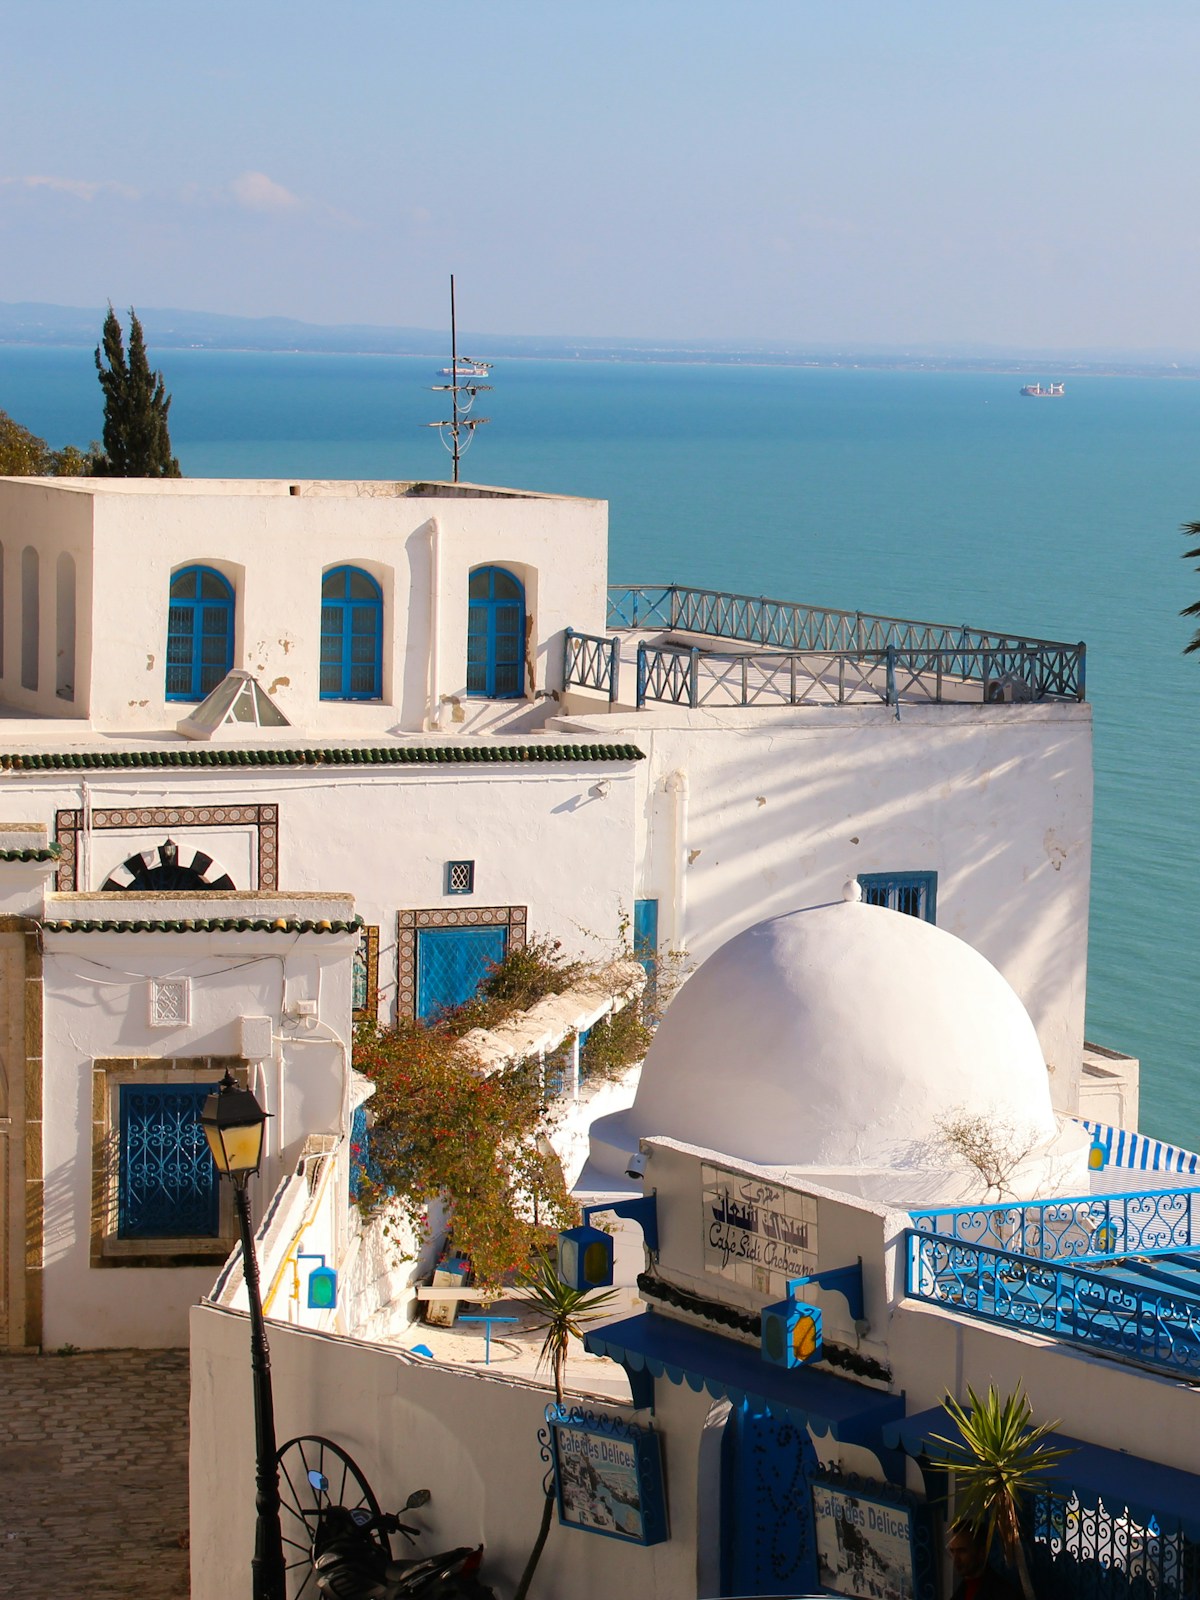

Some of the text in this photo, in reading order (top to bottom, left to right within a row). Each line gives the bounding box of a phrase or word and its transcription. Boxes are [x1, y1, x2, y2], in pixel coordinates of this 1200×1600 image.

[709, 1221, 736, 1271] Café
[736, 1234, 762, 1262] Sidi
[560, 1431, 636, 1469] Café des Délices
[845, 1502, 866, 1528] des
[868, 1506, 910, 1541] Délices
